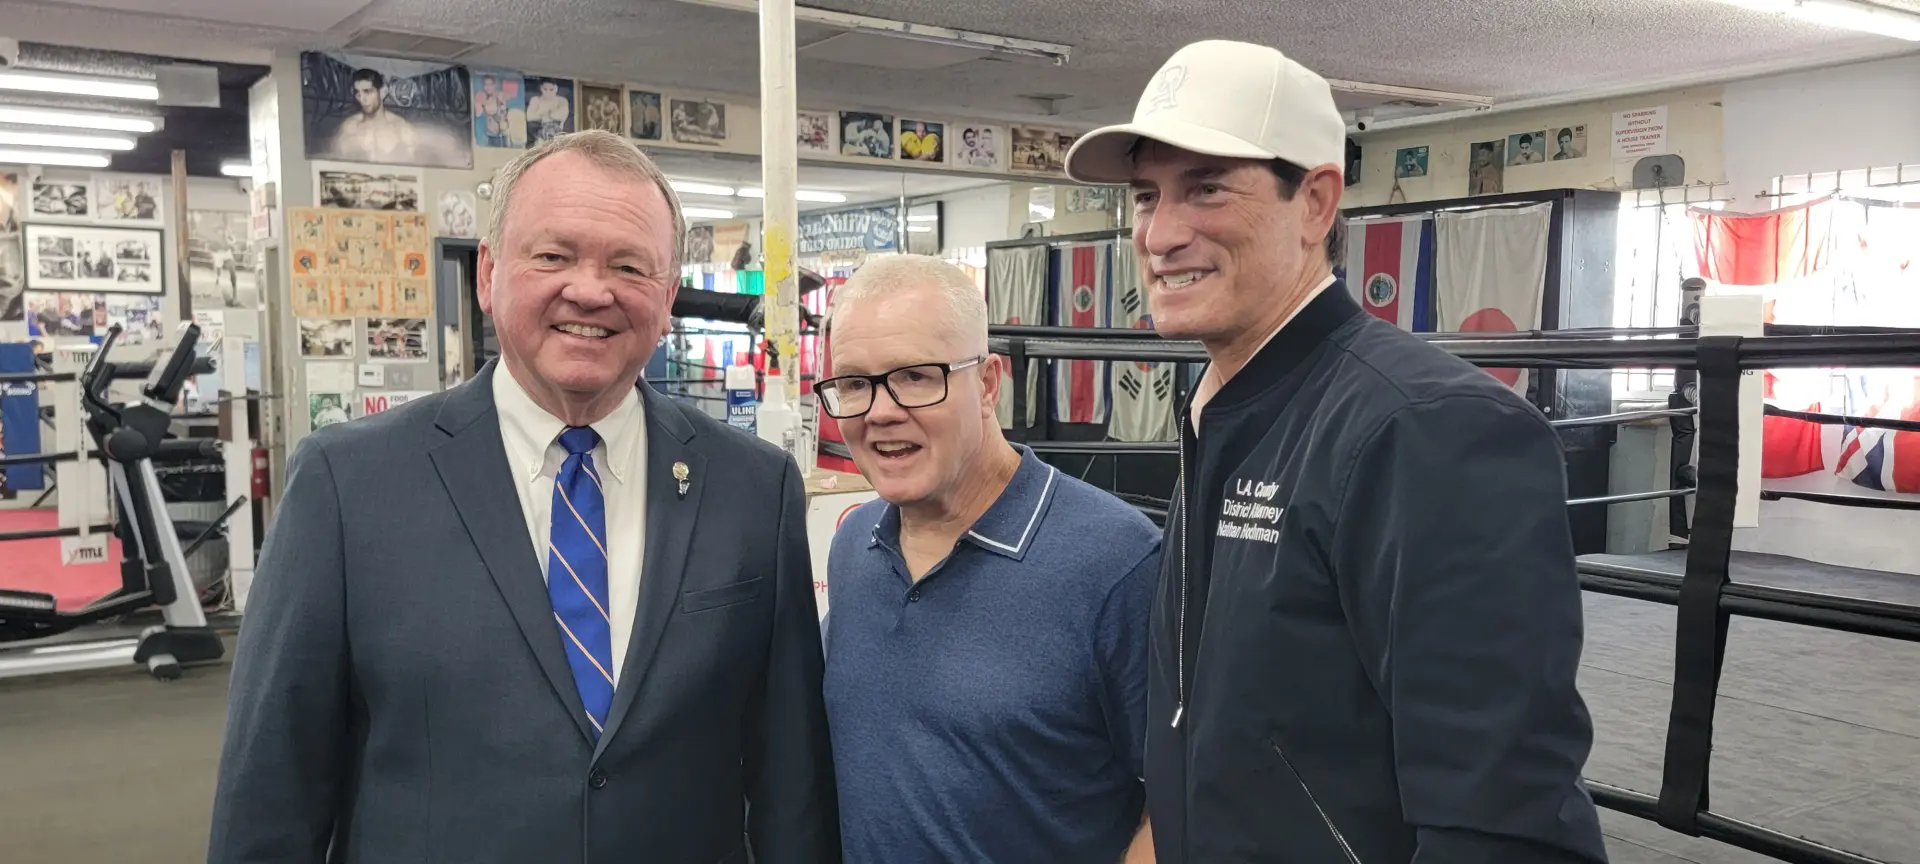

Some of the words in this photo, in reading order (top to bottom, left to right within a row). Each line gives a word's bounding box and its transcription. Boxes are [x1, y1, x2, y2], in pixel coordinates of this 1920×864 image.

[1639, 133, 1661, 141] TRAINER
[365, 395, 388, 415] NO
[1236, 478, 1253, 497] L.A.
[1223, 498, 1252, 519] District
[1216, 519, 1242, 539] Nathan
[80, 547, 104, 559] TITLE
